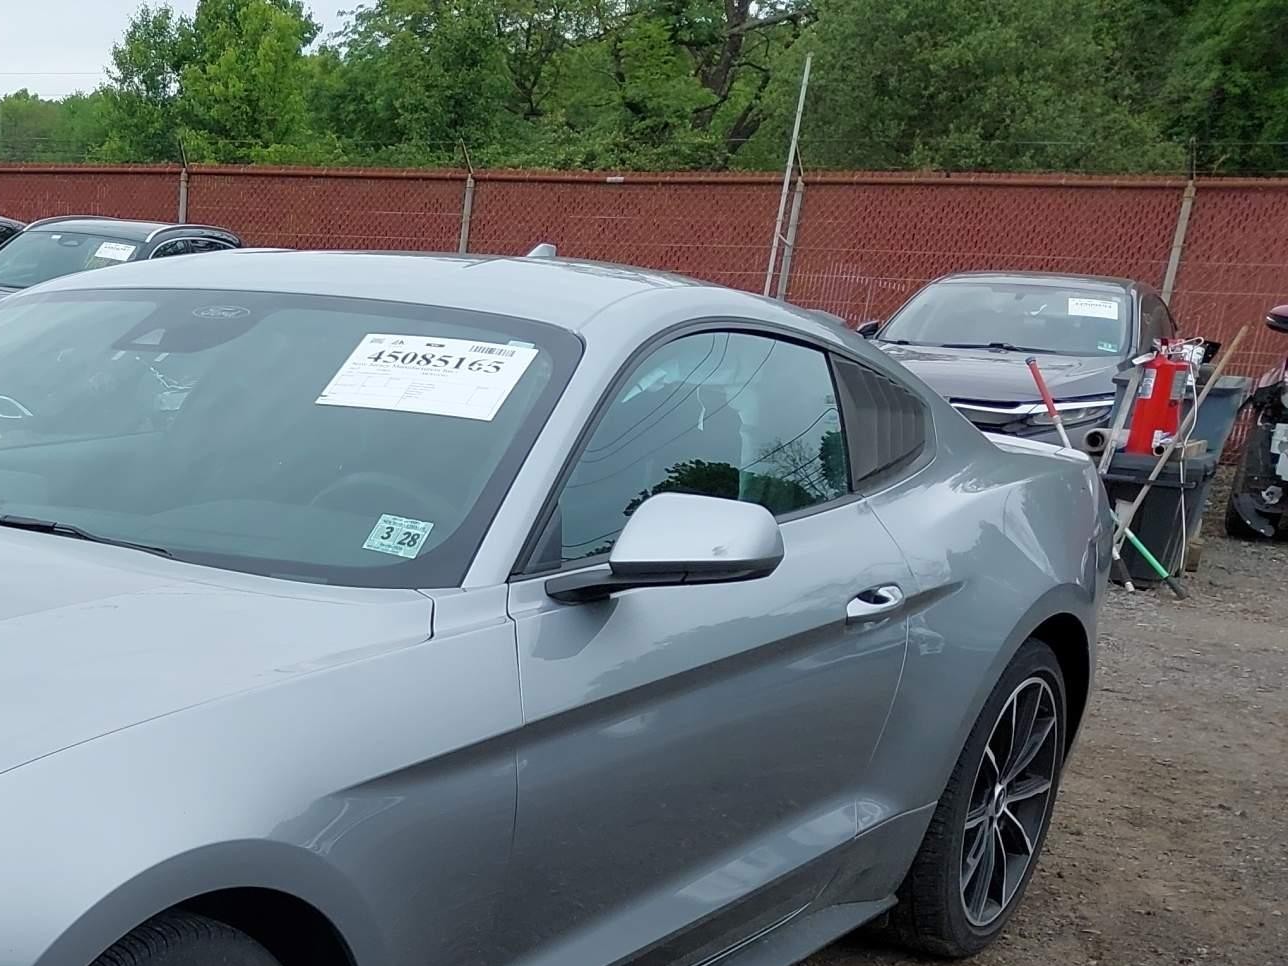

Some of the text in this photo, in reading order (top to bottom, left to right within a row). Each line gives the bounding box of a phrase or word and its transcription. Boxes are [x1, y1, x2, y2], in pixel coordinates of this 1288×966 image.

[367, 350, 505, 374] 45085165
[381, 526, 394, 540] 3
[397, 531, 421, 548] 28
